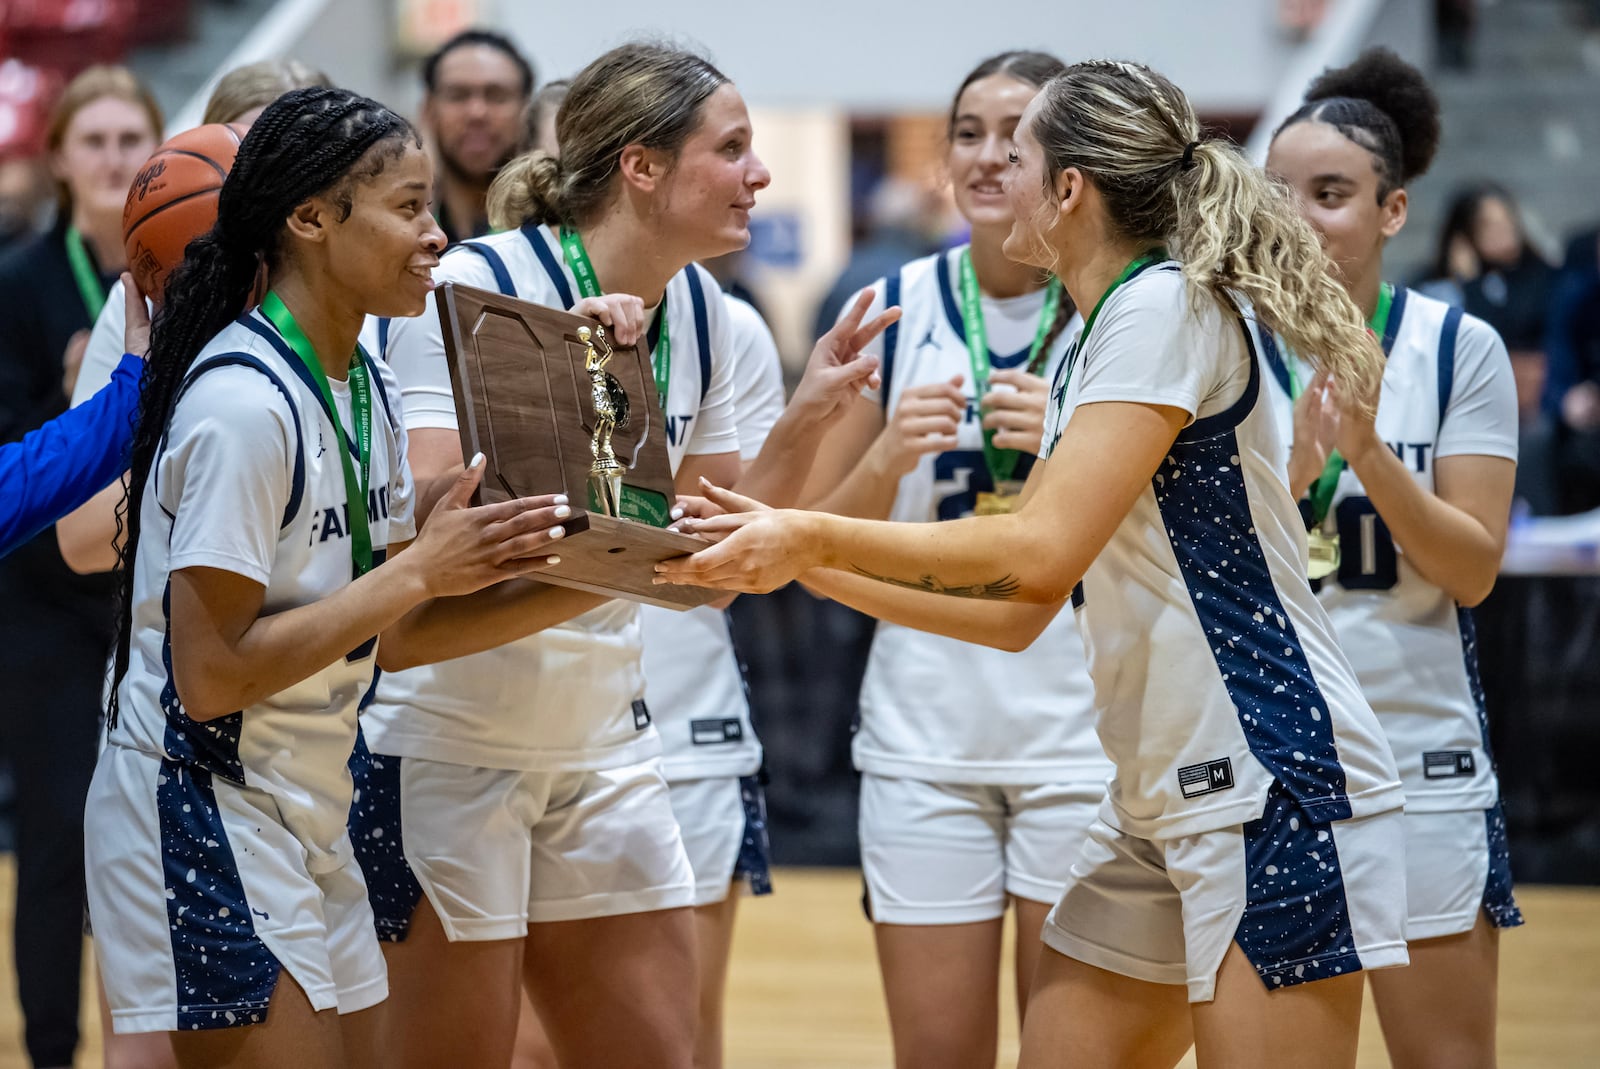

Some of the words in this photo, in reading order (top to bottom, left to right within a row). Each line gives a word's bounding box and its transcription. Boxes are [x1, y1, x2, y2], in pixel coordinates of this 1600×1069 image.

[355, 373, 367, 404] ATHLETIC
[361, 407, 369, 452] ASSOCIATION
[1461, 756, 1471, 769] M
[1213, 767, 1225, 782] M
